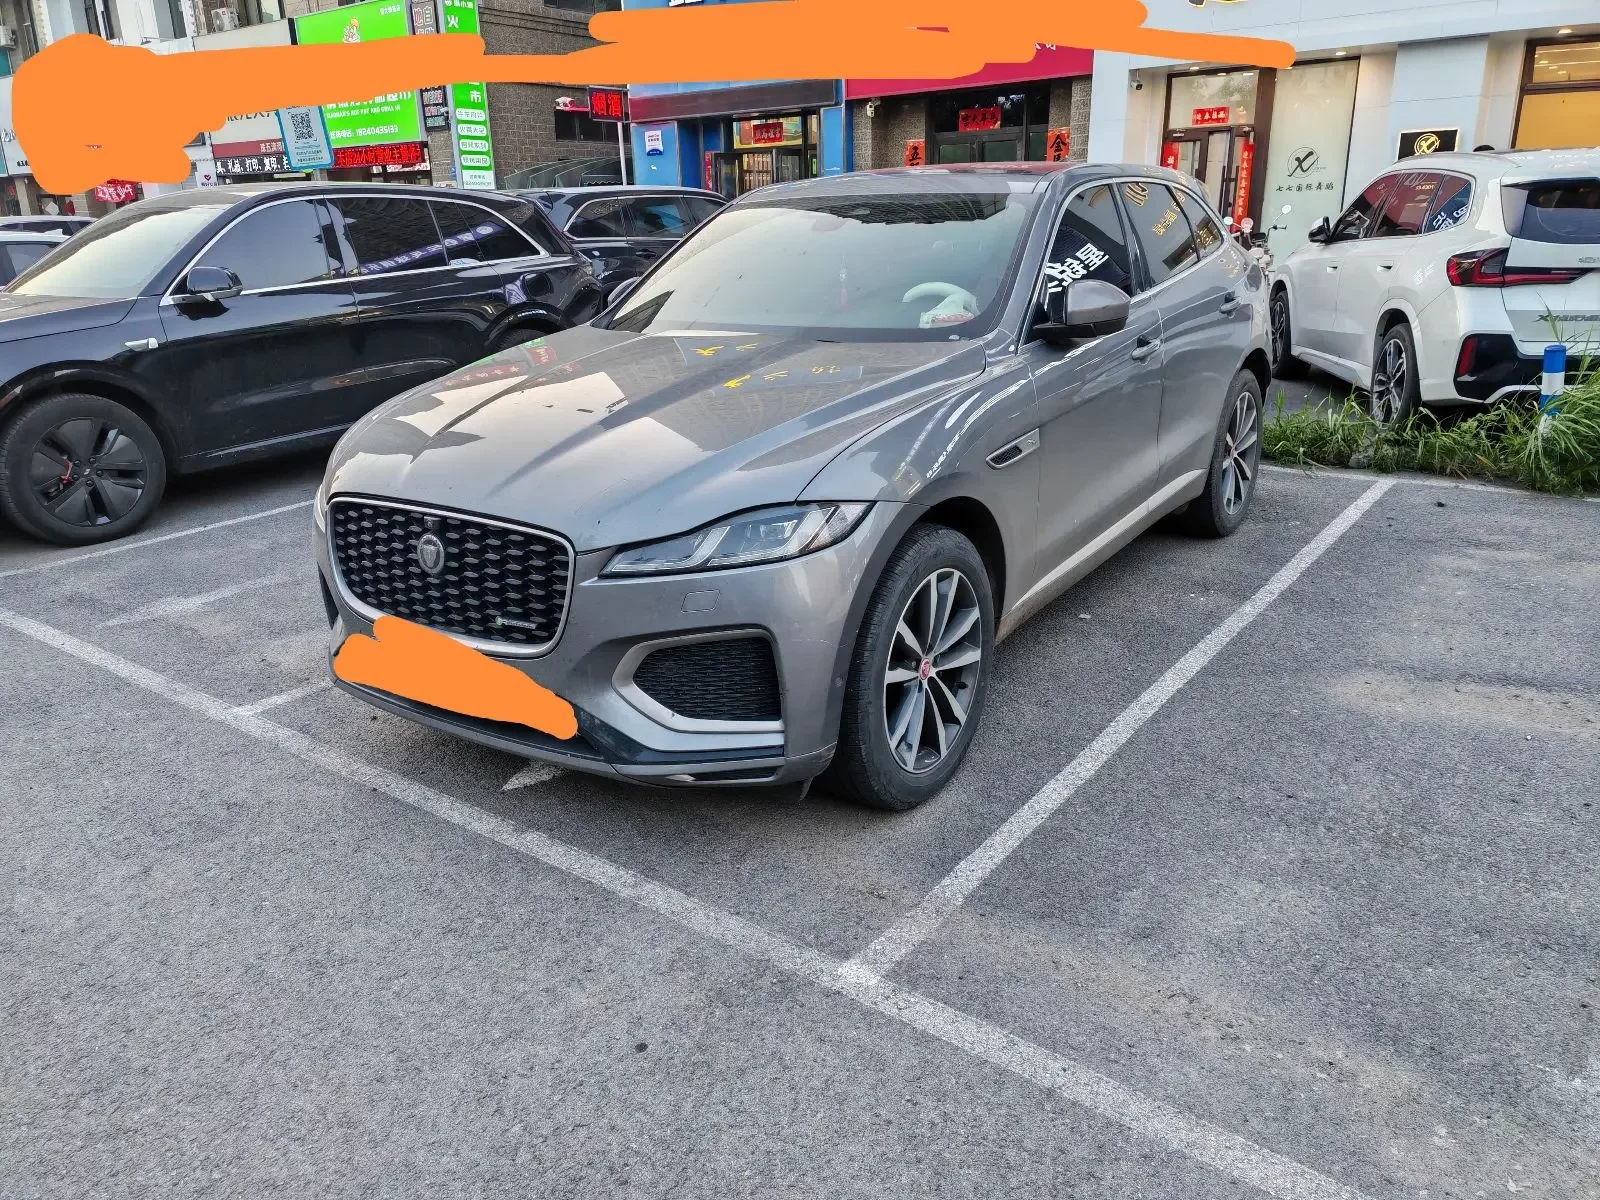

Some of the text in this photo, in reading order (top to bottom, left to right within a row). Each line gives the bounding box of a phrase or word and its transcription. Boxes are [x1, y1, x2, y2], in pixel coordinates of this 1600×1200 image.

[447, 14, 459, 29] 火
[470, 90, 481, 103] 市
[592, 91, 622, 117] 烟酒
[1275, 181, 1334, 193] 七七国际舞蹈
